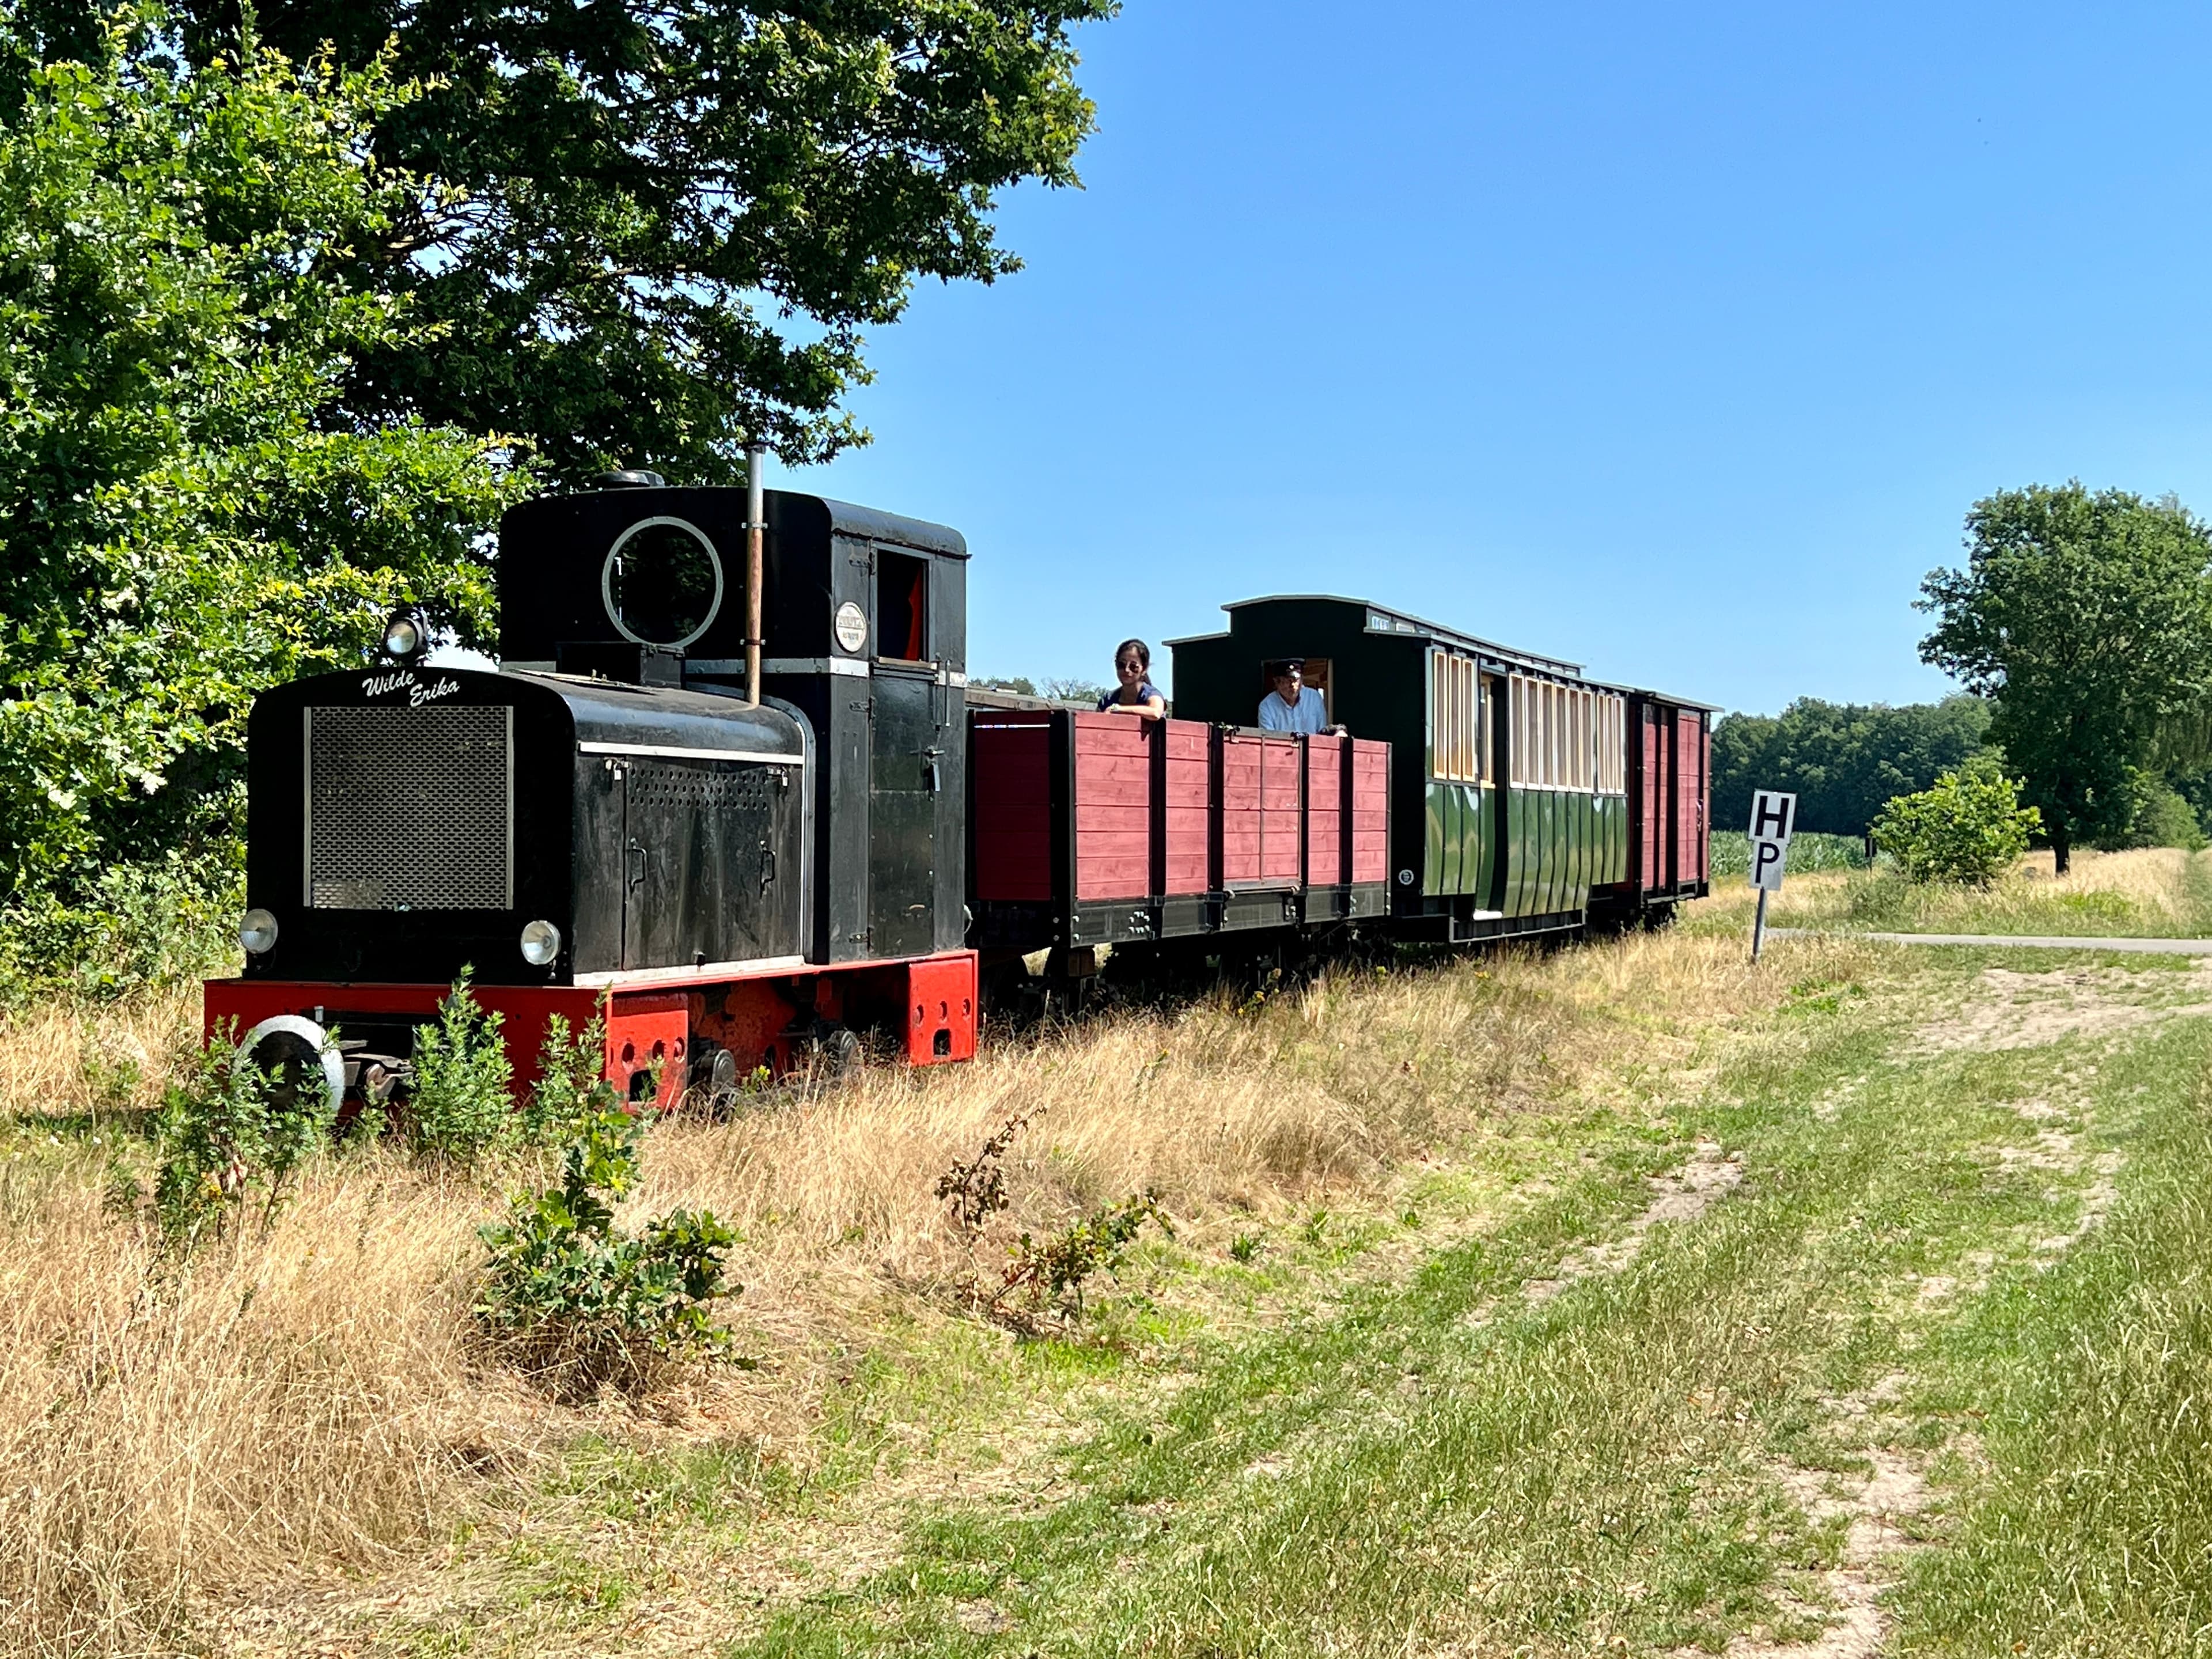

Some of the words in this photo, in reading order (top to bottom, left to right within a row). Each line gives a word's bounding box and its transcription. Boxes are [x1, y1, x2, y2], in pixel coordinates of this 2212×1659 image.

[362, 669, 415, 697] Wilde
[410, 677, 460, 707] Erika
[1754, 795, 1790, 839] H
[1755, 842, 1780, 884] P
